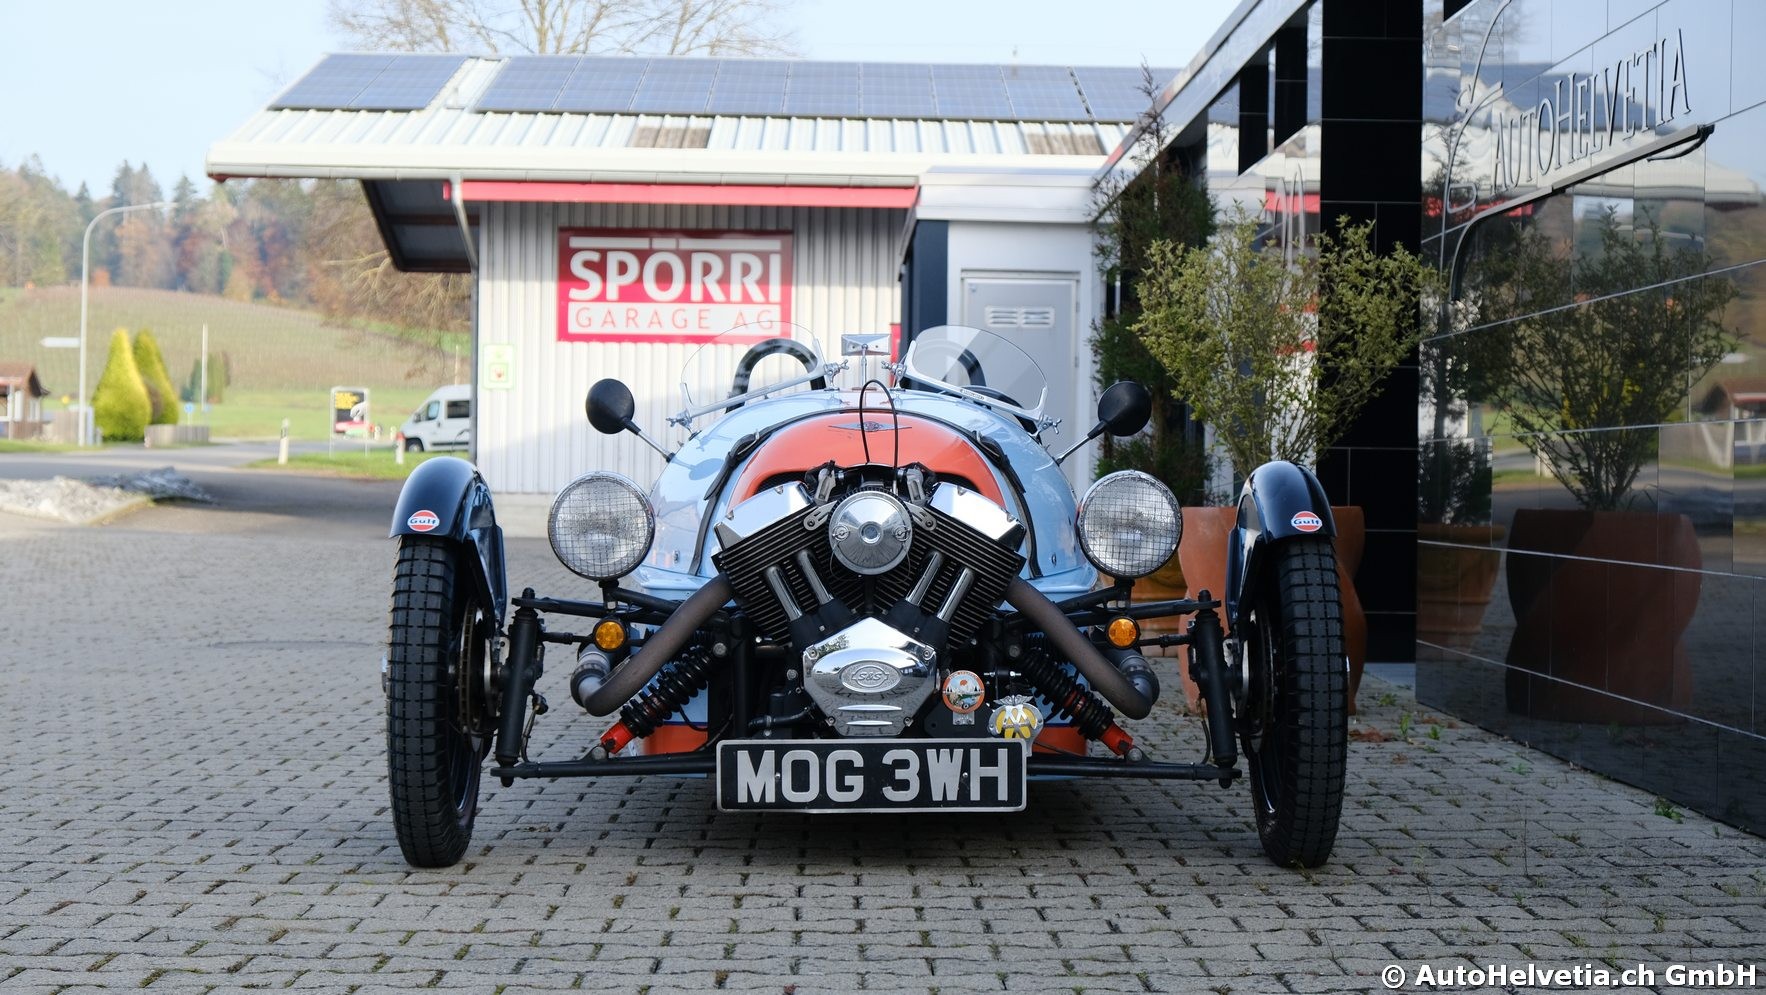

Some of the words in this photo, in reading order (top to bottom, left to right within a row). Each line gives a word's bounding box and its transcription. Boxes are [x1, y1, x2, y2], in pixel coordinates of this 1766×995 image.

[1490, 27, 1692, 196] AUTOHELVETIA
[575, 306, 711, 330] GARAGE
[734, 310, 774, 330] AG
[857, 671, 883, 681] S&S
[737, 749, 864, 803] MOG
[882, 748, 1008, 802] 3WH
